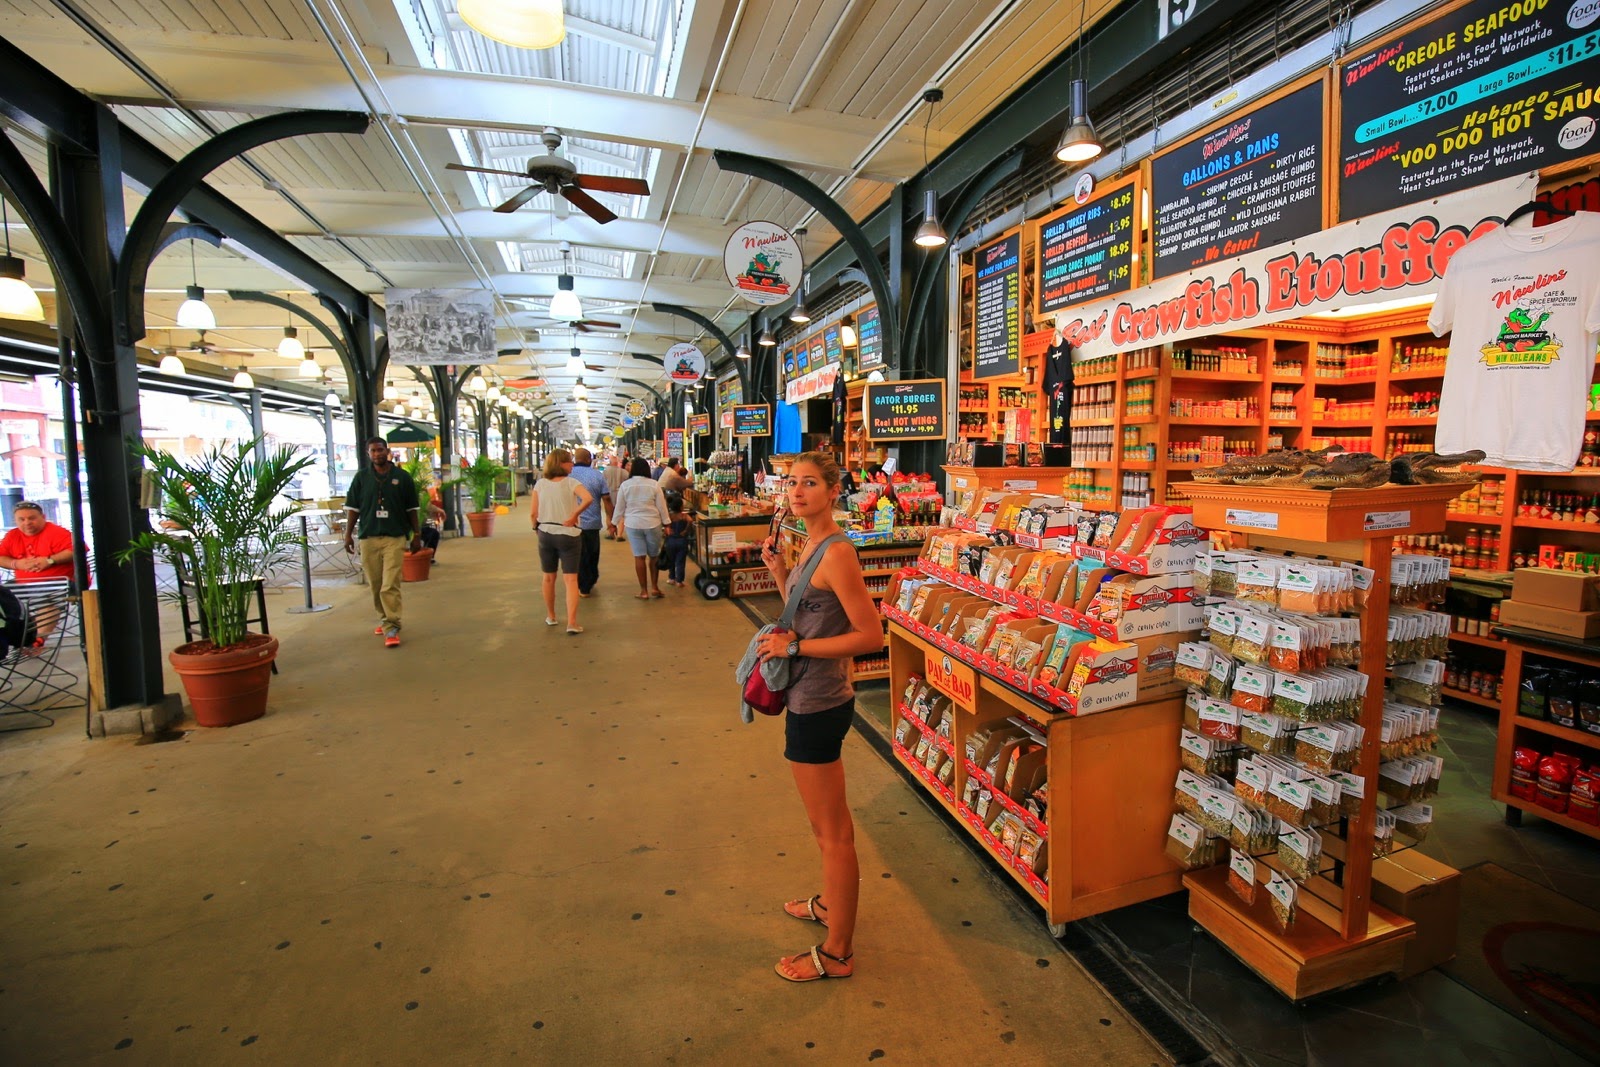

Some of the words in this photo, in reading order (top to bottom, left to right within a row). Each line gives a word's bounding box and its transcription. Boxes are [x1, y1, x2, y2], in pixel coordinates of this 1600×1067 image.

[1405, 70, 1440, 85] Featured
[1443, 61, 1453, 69] on
[1456, 52, 1470, 64] the
[1474, 40, 1495, 55] Food
[1499, 20, 1540, 44] Network
[1430, 65, 1463, 84] Seekers
[1502, 28, 1552, 54] Worldwide
[1479, 79, 1503, 93] Large
[1548, 35, 1600, 64] $11.5
[1365, 122, 1385, 137] Small
[1417, 91, 1457, 114] $7.00
[1461, 90, 1549, 130] Habaneo
[1235, 133, 1249, 144] CAFE
[1443, 127, 1483, 153] DOO
[1492, 110, 1535, 138] HOT
[1559, 118, 1594, 141] food
[1182, 156, 1230, 186] GALLONS
[1234, 151, 1243, 165] &
[1246, 133, 1279, 160] PANS
[1276, 153, 1296, 169] DIRTY
[1298, 145, 1315, 159] RICE
[1400, 167, 1435, 184] Featured
[1438, 163, 1448, 171] on
[1451, 156, 1465, 167] the
[1468, 146, 1489, 162] Food
[1493, 136, 1533, 156] Network
[1427, 171, 1457, 187] Seekers
[1495, 146, 1544, 165] Worldwide
[1206, 180, 1228, 196] SHRIMP
[1230, 171, 1253, 188] CREOLE
[1227, 183, 1252, 201] CHICKEN
[1253, 182, 1258, 191] &
[1260, 172, 1288, 190] SAUSAGE
[1291, 160, 1315, 178] GUMBO
[1247, 187, 1280, 204] CRAWFISH
[1282, 172, 1316, 192] ETOUFFEE
[1046, 223, 1064, 239] GRILLED
[1067, 212, 1086, 228] TURKEY
[1111, 192, 1131, 209] $8.95
[1159, 197, 1189, 214] JAMBALAYA
[1159, 214, 1170, 225] FILÉ
[1172, 206, 1195, 220] SEAFOOD
[1197, 197, 1217, 212] GUMBO
[1236, 209, 1251, 221] WILD
[1253, 196, 1287, 216] LOUISIANA
[1290, 186, 1316, 204] RABBIT
[1046, 244, 1064, 259] GRILLED
[1066, 232, 1088, 251] REDFISH
[1110, 216, 1130, 234] 13.95
[1159, 234, 1182, 247] SEAFOOD
[1184, 228, 1199, 239] OKRA
[1200, 220, 1220, 233] GUMBO
[1159, 245, 1177, 257] SHRIMP
[1181, 235, 1209, 251] CRAWFISH
[1217, 222, 1249, 239] ALLIGATOR
[1251, 212, 1281, 228] SAUSAGE
[1160, 220, 1187, 236] ALLIGATOR
[1189, 215, 1206, 226] SAUCE
[1223, 231, 1260, 255] Cater!
[978, 269, 984, 278] WE
[985, 266, 994, 276] PACK
[1004, 256, 1017, 267] TRAVEL
[1045, 264, 1067, 280] ALLIGATOR
[1068, 258, 1083, 273] SAUCE
[1084, 250, 1105, 266] PIQUANT
[1110, 241, 1129, 257] 18.95
[1064, 280, 1076, 294] WILD
[1078, 275, 1097, 289] RABBIT
[1109, 265, 1128, 284] 14.95
[1062, 309, 1108, 348] Best
[1110, 267, 1260, 347] Crawfish
[1496, 354, 1506, 362] NEW
[1510, 353, 1547, 362] ORLEANS
[875, 396, 900, 405] GATOR
[904, 394, 935, 403] BURGER
[892, 405, 918, 414] $11.95
[874, 418, 890, 427] Real
[893, 417, 908, 426] HOT
[911, 416, 937, 425] WINGS
[752, 572, 768, 580] WE
[928, 659, 942, 682] PAY
[952, 674, 971, 702] BAR
